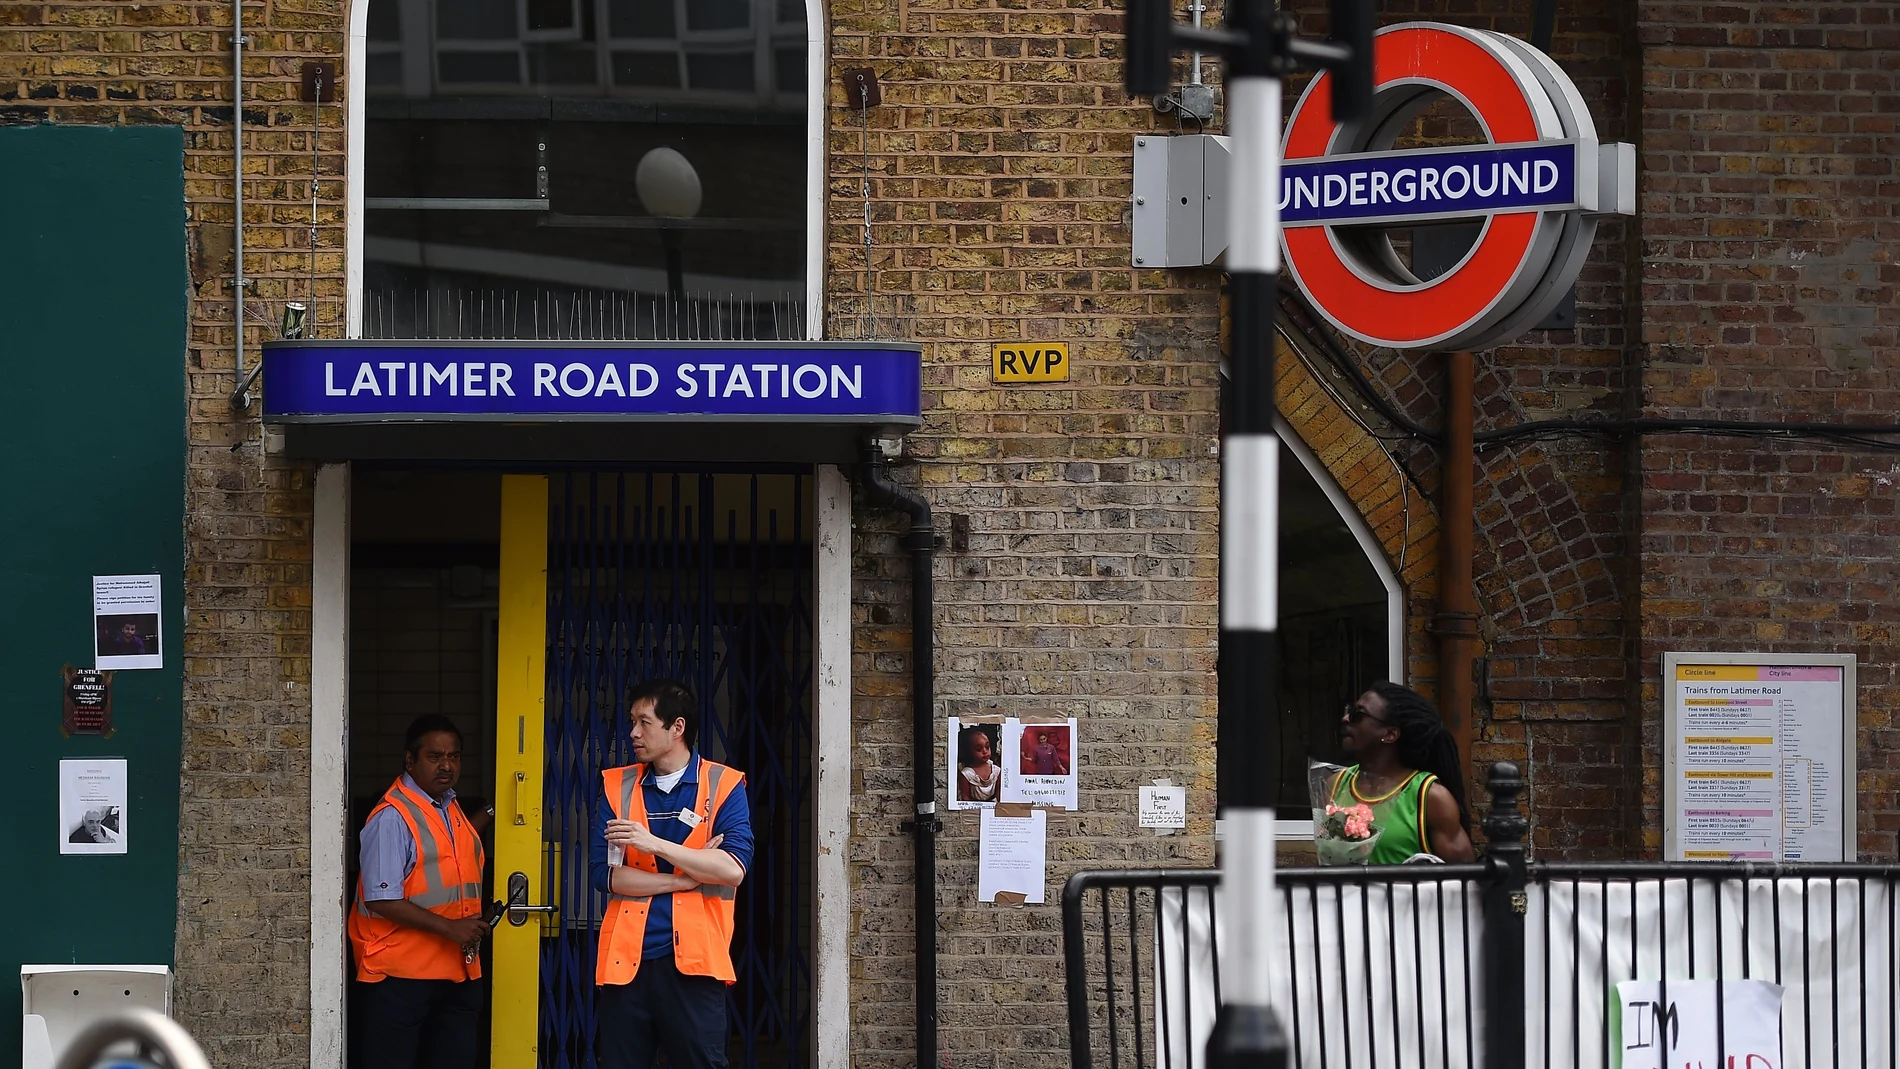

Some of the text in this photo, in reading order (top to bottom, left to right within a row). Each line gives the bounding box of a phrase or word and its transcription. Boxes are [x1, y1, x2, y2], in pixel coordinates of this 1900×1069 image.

[1000, 350, 1063, 375] RVP
[324, 361, 864, 400] LATIMER ROAD STATION
[1685, 686, 1782, 695] Trains from Latimer Road
